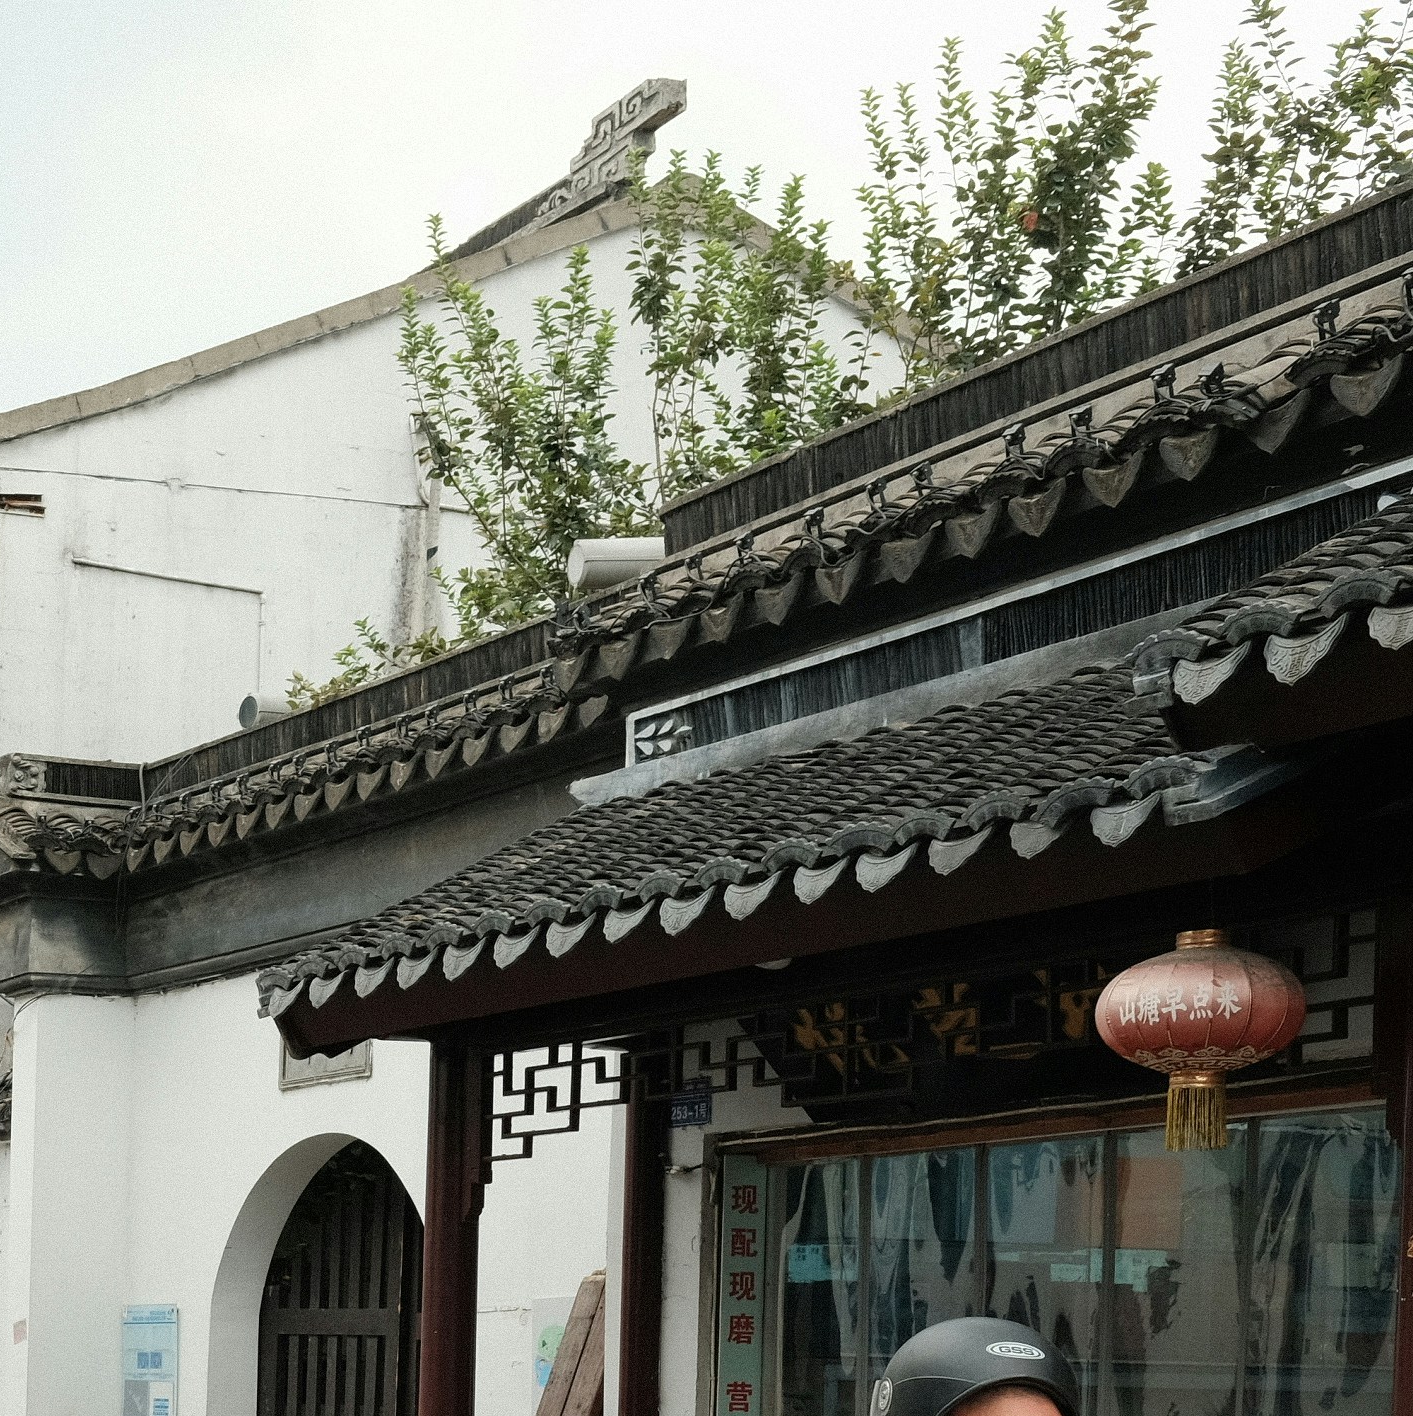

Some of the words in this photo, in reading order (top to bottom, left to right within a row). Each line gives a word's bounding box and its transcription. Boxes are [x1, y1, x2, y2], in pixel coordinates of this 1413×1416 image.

[671, 1103, 707, 1120] 253-1号
[727, 1183, 760, 1345] 现配现磨
[998, 1346, 1035, 1356] GSS
